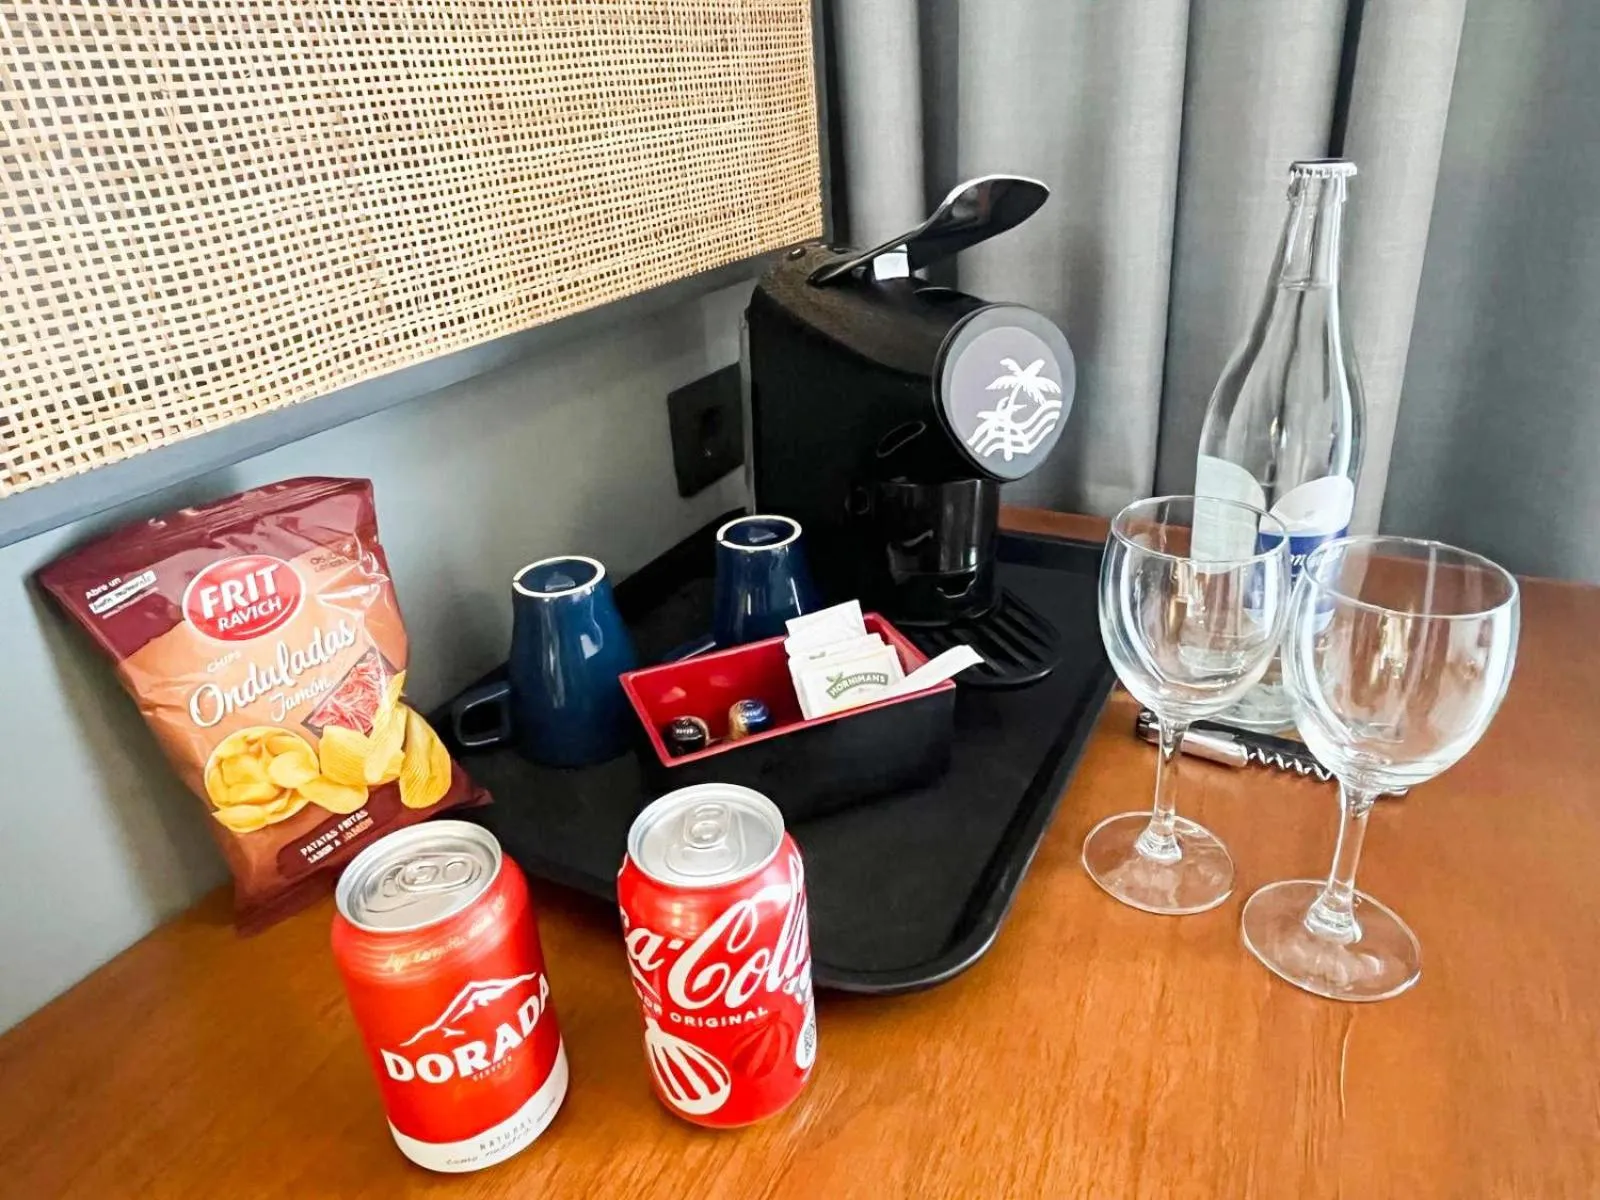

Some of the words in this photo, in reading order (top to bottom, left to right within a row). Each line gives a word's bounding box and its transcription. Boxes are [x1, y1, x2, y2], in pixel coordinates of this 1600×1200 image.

[86, 583, 109, 600] Abre
[107, 577, 122, 590] un
[200, 564, 280, 620] FRIT
[218, 597, 282, 632] RAVICH
[189, 616, 356, 727] Onduladas
[829, 675, 886, 697] HORNIMANS
[300, 829, 339, 857] PATATAS
[380, 973, 549, 1083] DORADA
[670, 1007, 768, 1028] ORIGINAL
